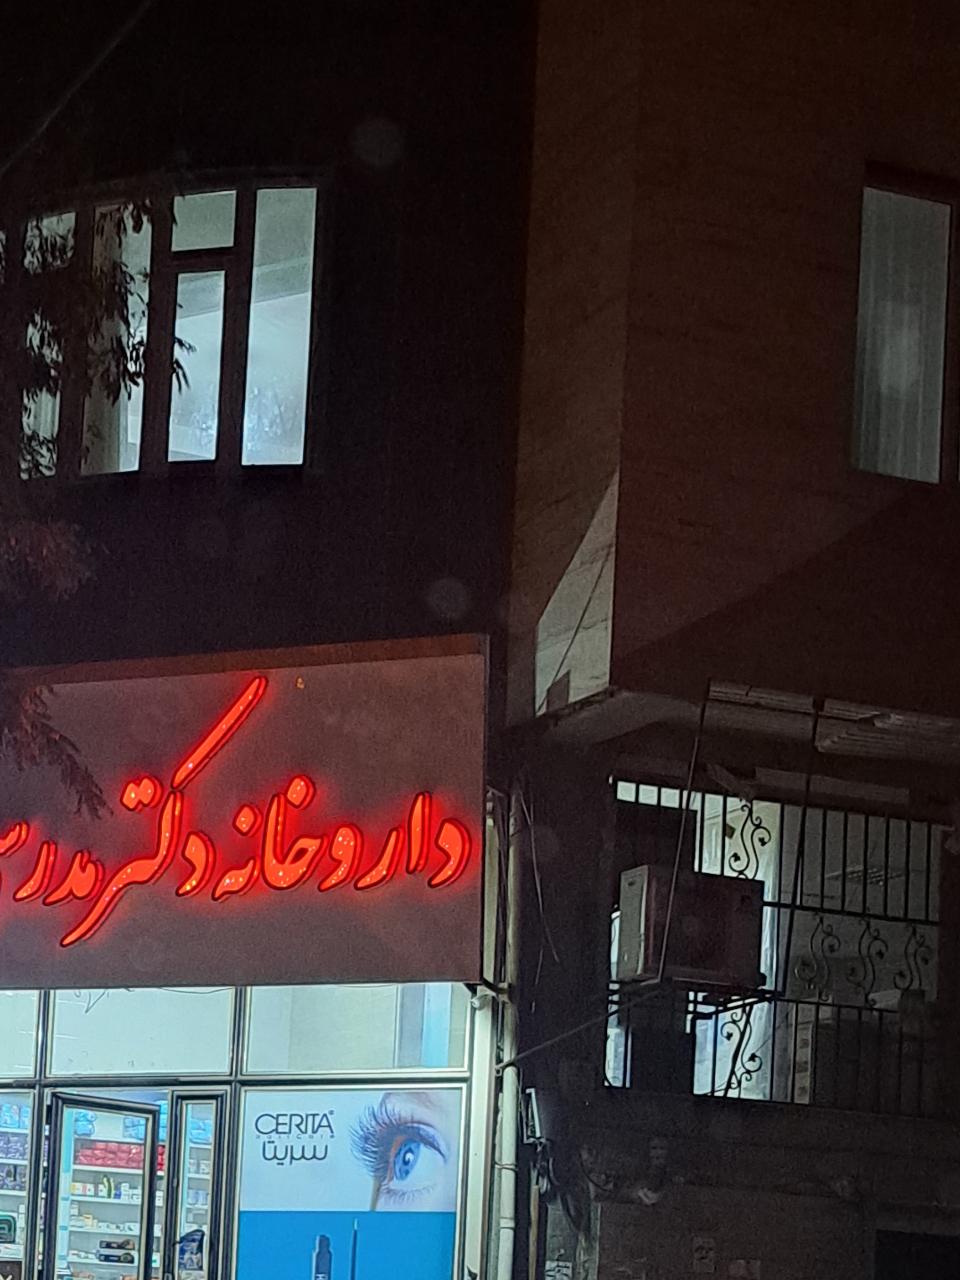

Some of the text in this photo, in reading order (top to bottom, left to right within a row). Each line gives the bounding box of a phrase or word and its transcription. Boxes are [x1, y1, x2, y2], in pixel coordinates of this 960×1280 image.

[60, 674, 270, 947] دکتر
[213, 774, 472, 902] داروخانه
[255, 1113, 334, 1134] CERITA
[262, 1140, 328, 1166] سریتا
